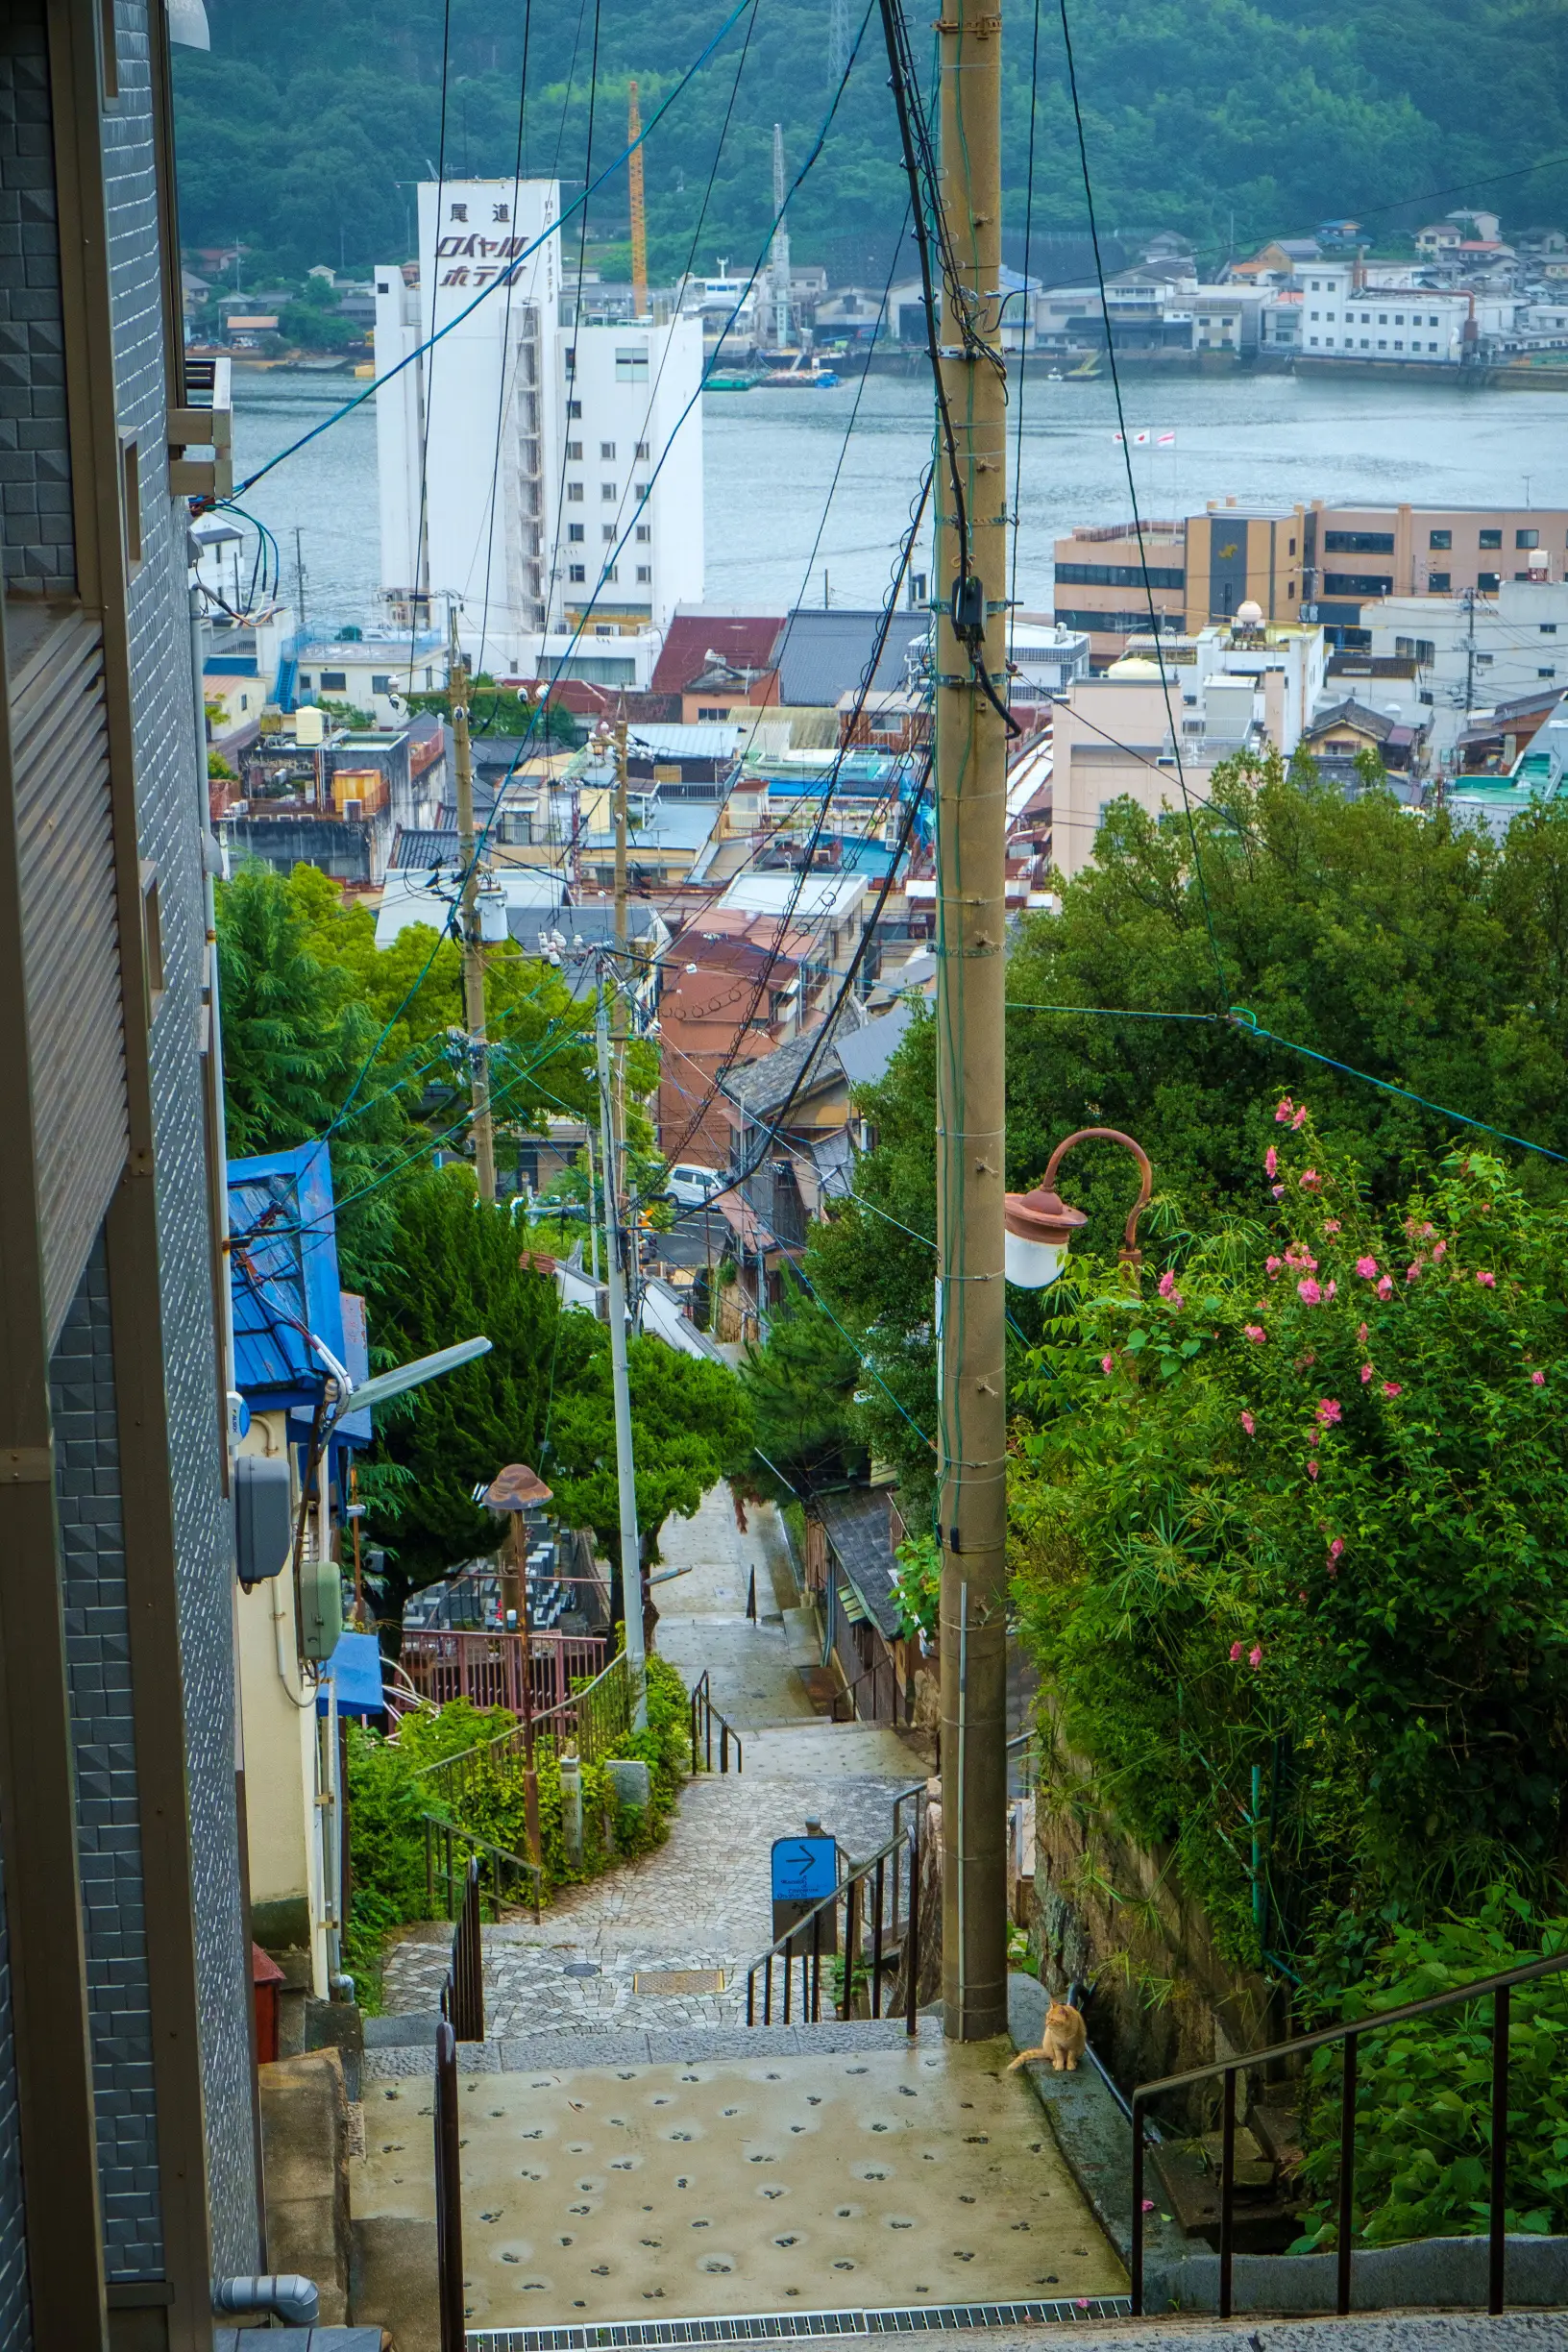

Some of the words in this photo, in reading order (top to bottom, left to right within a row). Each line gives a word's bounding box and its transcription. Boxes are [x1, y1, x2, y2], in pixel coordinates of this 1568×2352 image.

[450, 203, 510, 223] 尾道
[434, 233, 529, 257] ロイヤル
[439, 266, 527, 286] ホテル
